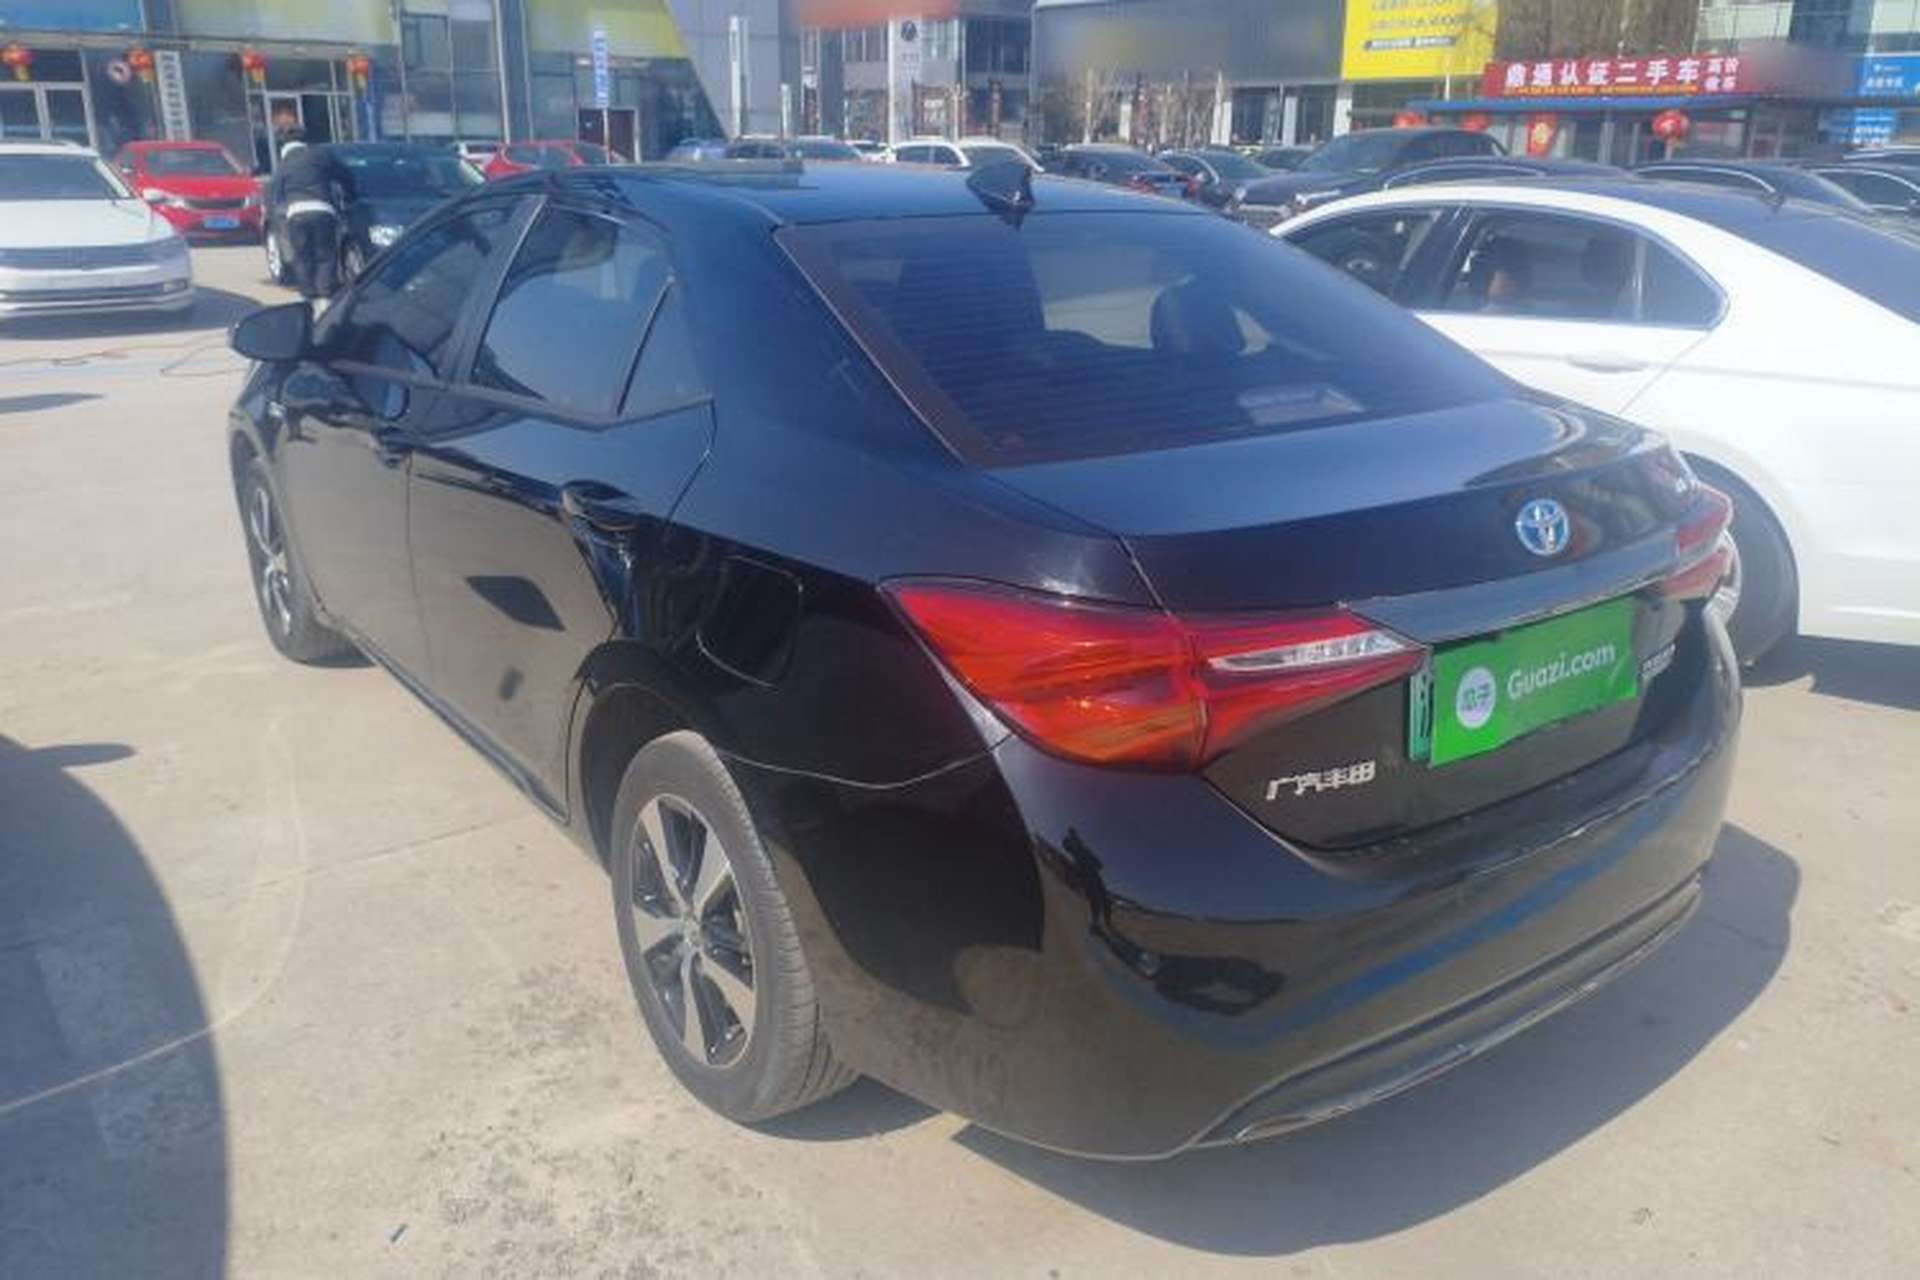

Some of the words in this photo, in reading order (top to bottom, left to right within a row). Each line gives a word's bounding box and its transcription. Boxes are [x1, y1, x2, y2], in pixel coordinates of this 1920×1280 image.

[1507, 644, 1616, 701] Guazi.com
[1265, 760, 1376, 801] 广汽丰田
